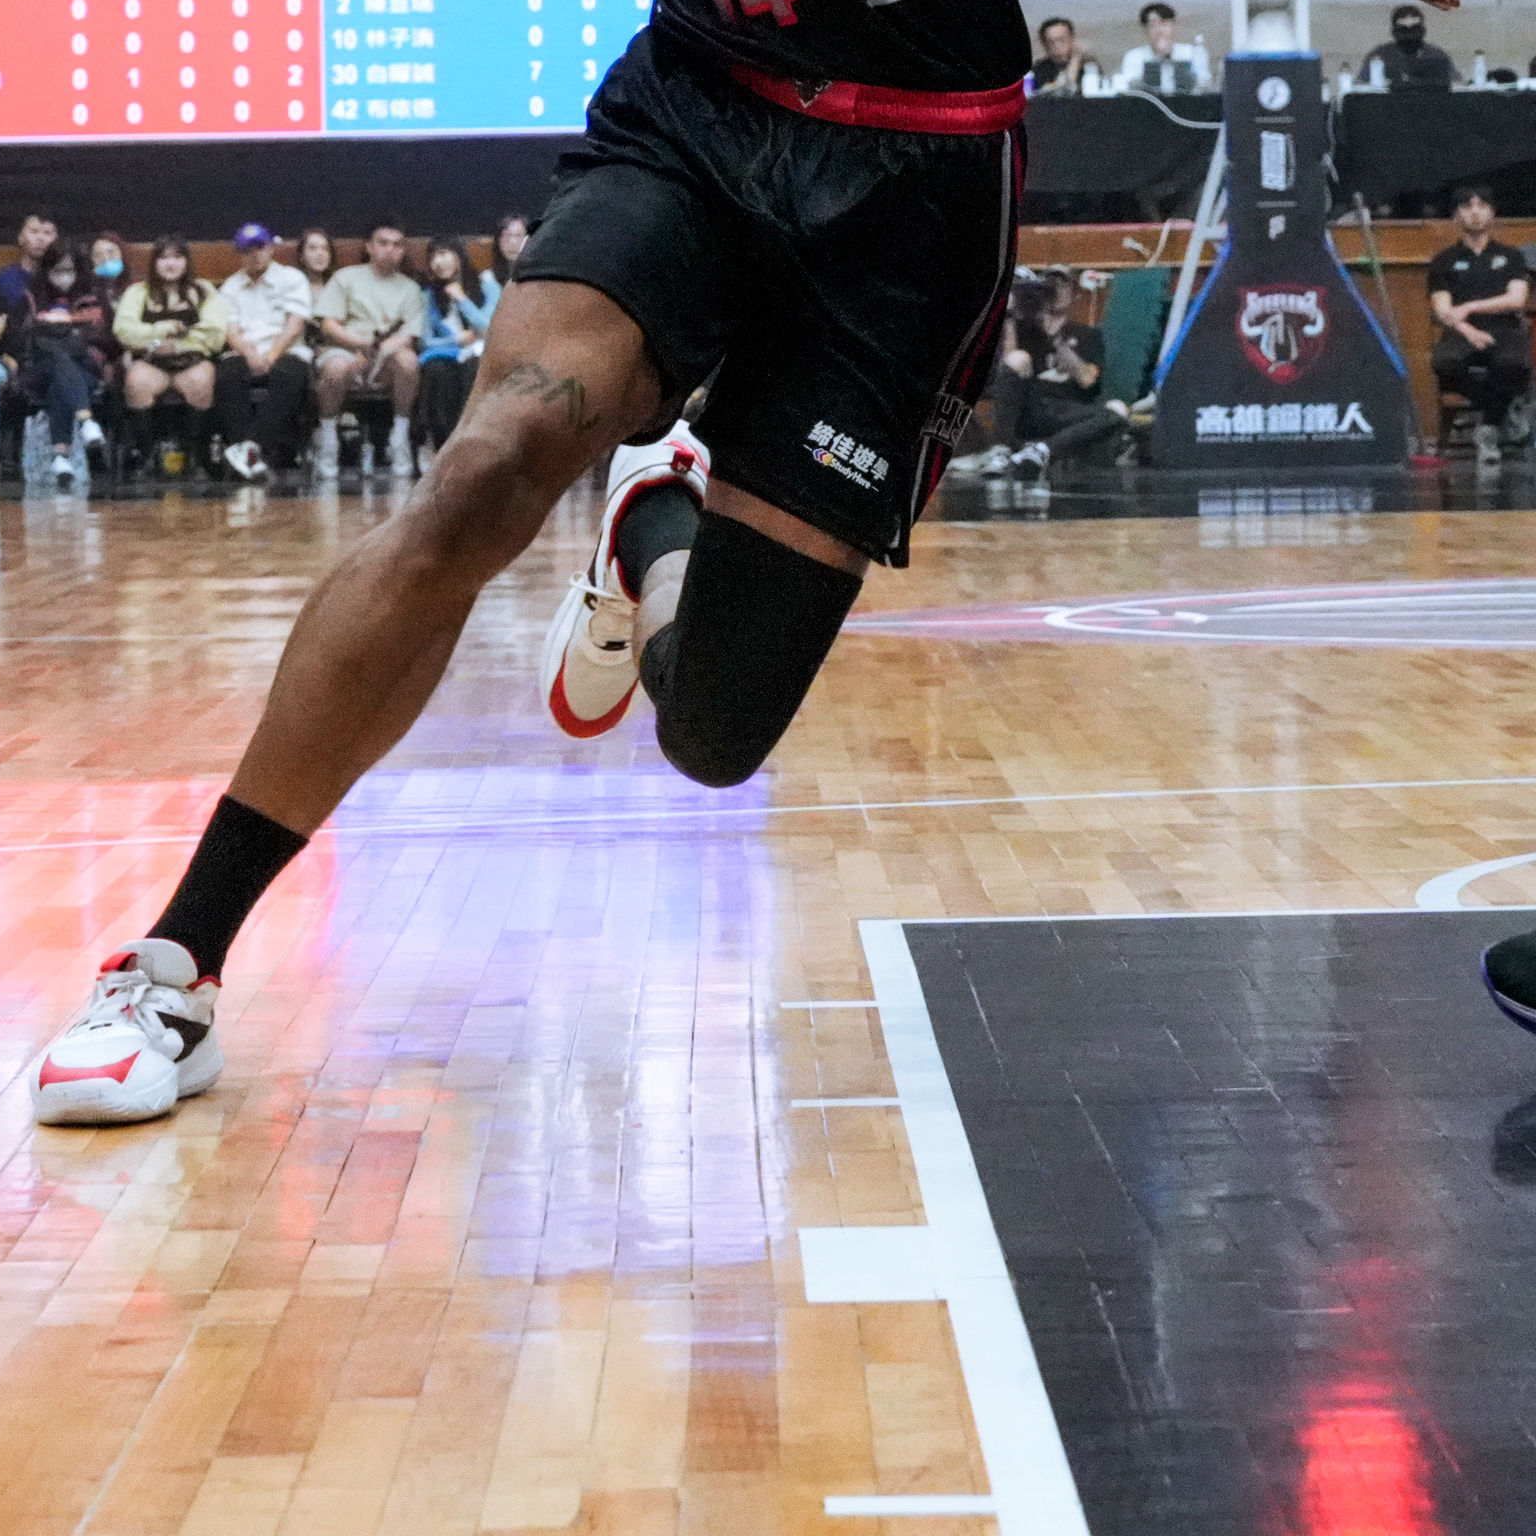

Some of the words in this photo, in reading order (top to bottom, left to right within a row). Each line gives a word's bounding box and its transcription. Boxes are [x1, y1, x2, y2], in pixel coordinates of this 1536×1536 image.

[71, 33, 88, 55] 0
[125, 32, 141, 54] 0
[179, 31, 195, 53] 0
[233, 30, 249, 53] 0
[286, 29, 303, 52] 0
[332, 28, 358, 50] 10
[528, 25, 544, 47] 0
[582, 24, 597, 46] 0
[72, 68, 88, 90] 0
[128, 68, 140, 88] 1
[179, 66, 196, 88] 0
[234, 65, 250, 87] 0
[287, 64, 303, 87] 2
[332, 63, 359, 86] 30
[530, 60, 543, 81] 7
[584, 59, 598, 81] 3
[72, 103, 89, 126] 0
[126, 102, 143, 124] 0
[180, 101, 196, 124] 0
[234, 100, 250, 122] 0
[288, 99, 304, 122] 0
[331, 98, 359, 120] 42
[529, 95, 545, 117] 0
